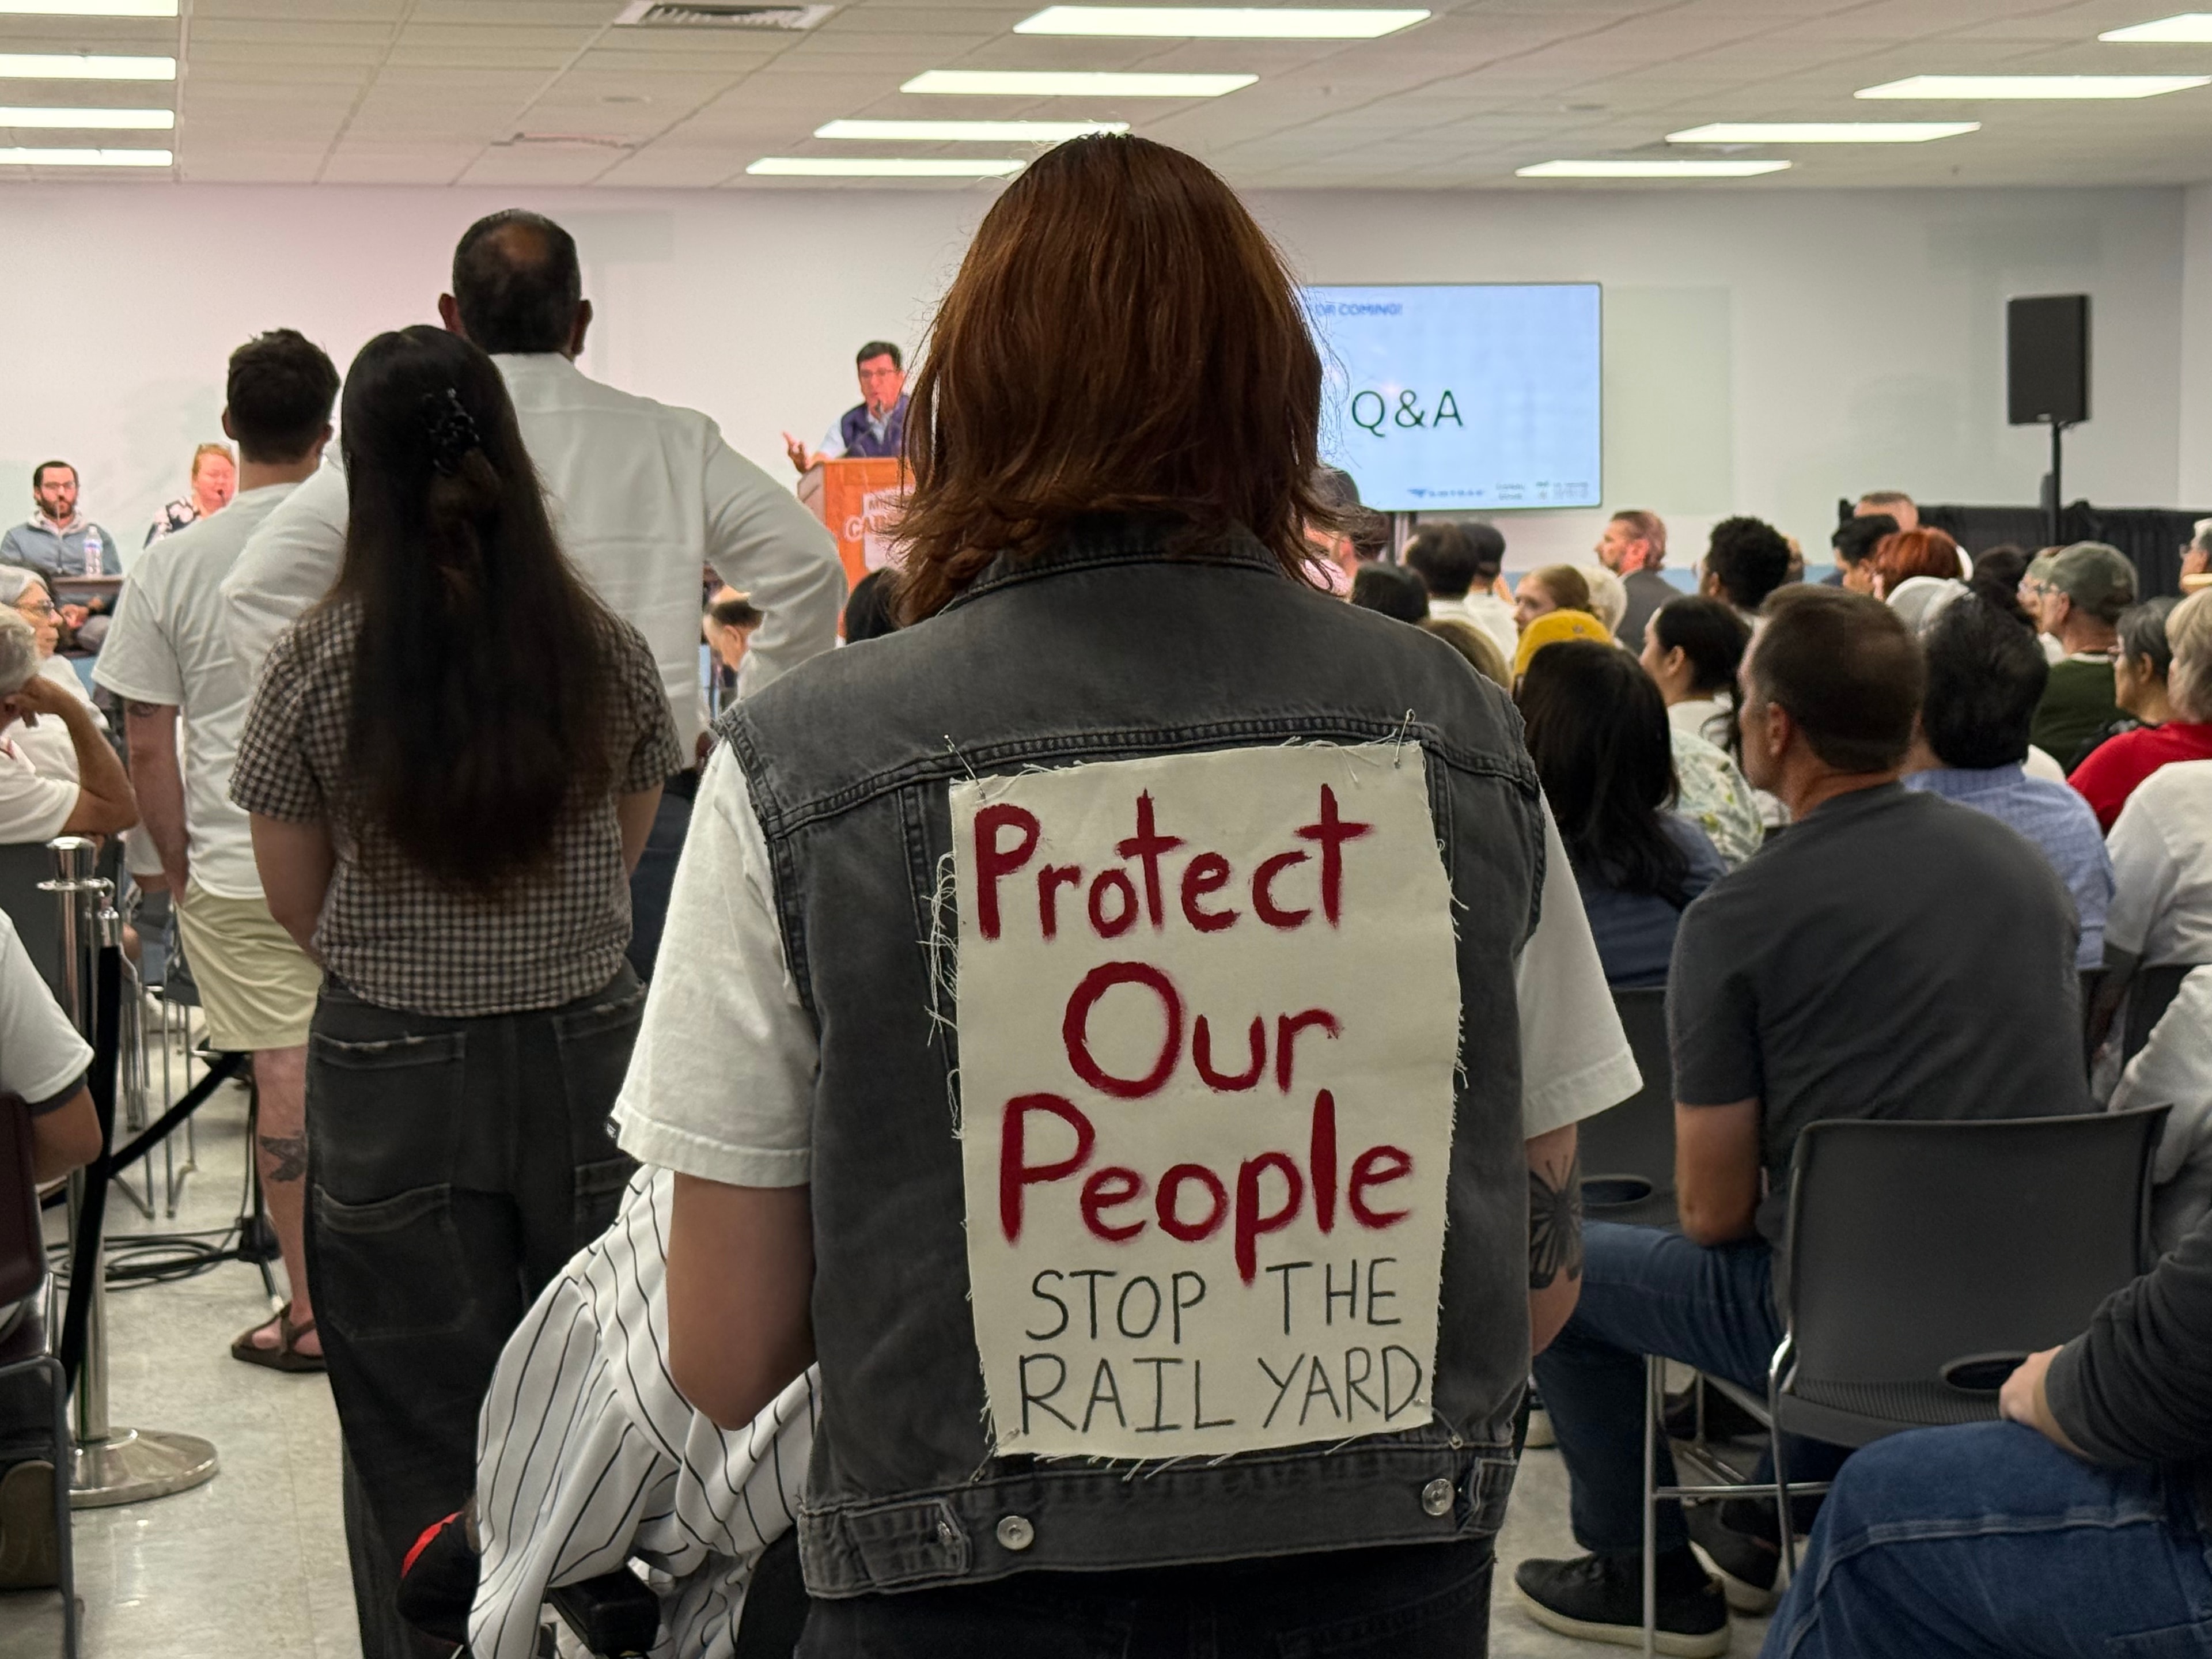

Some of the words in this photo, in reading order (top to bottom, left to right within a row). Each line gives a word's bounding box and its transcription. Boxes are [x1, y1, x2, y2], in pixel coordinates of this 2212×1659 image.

[972, 783, 1372, 940] Protect
[1063, 962, 1339, 1098] Our
[999, 1090, 1411, 1285] People
[1025, 1268, 1207, 1345] STOP
[1265, 1257, 1402, 1336] THE
[1018, 1352, 1236, 1435] RAIL
[1257, 1344, 1423, 1429] YARD
